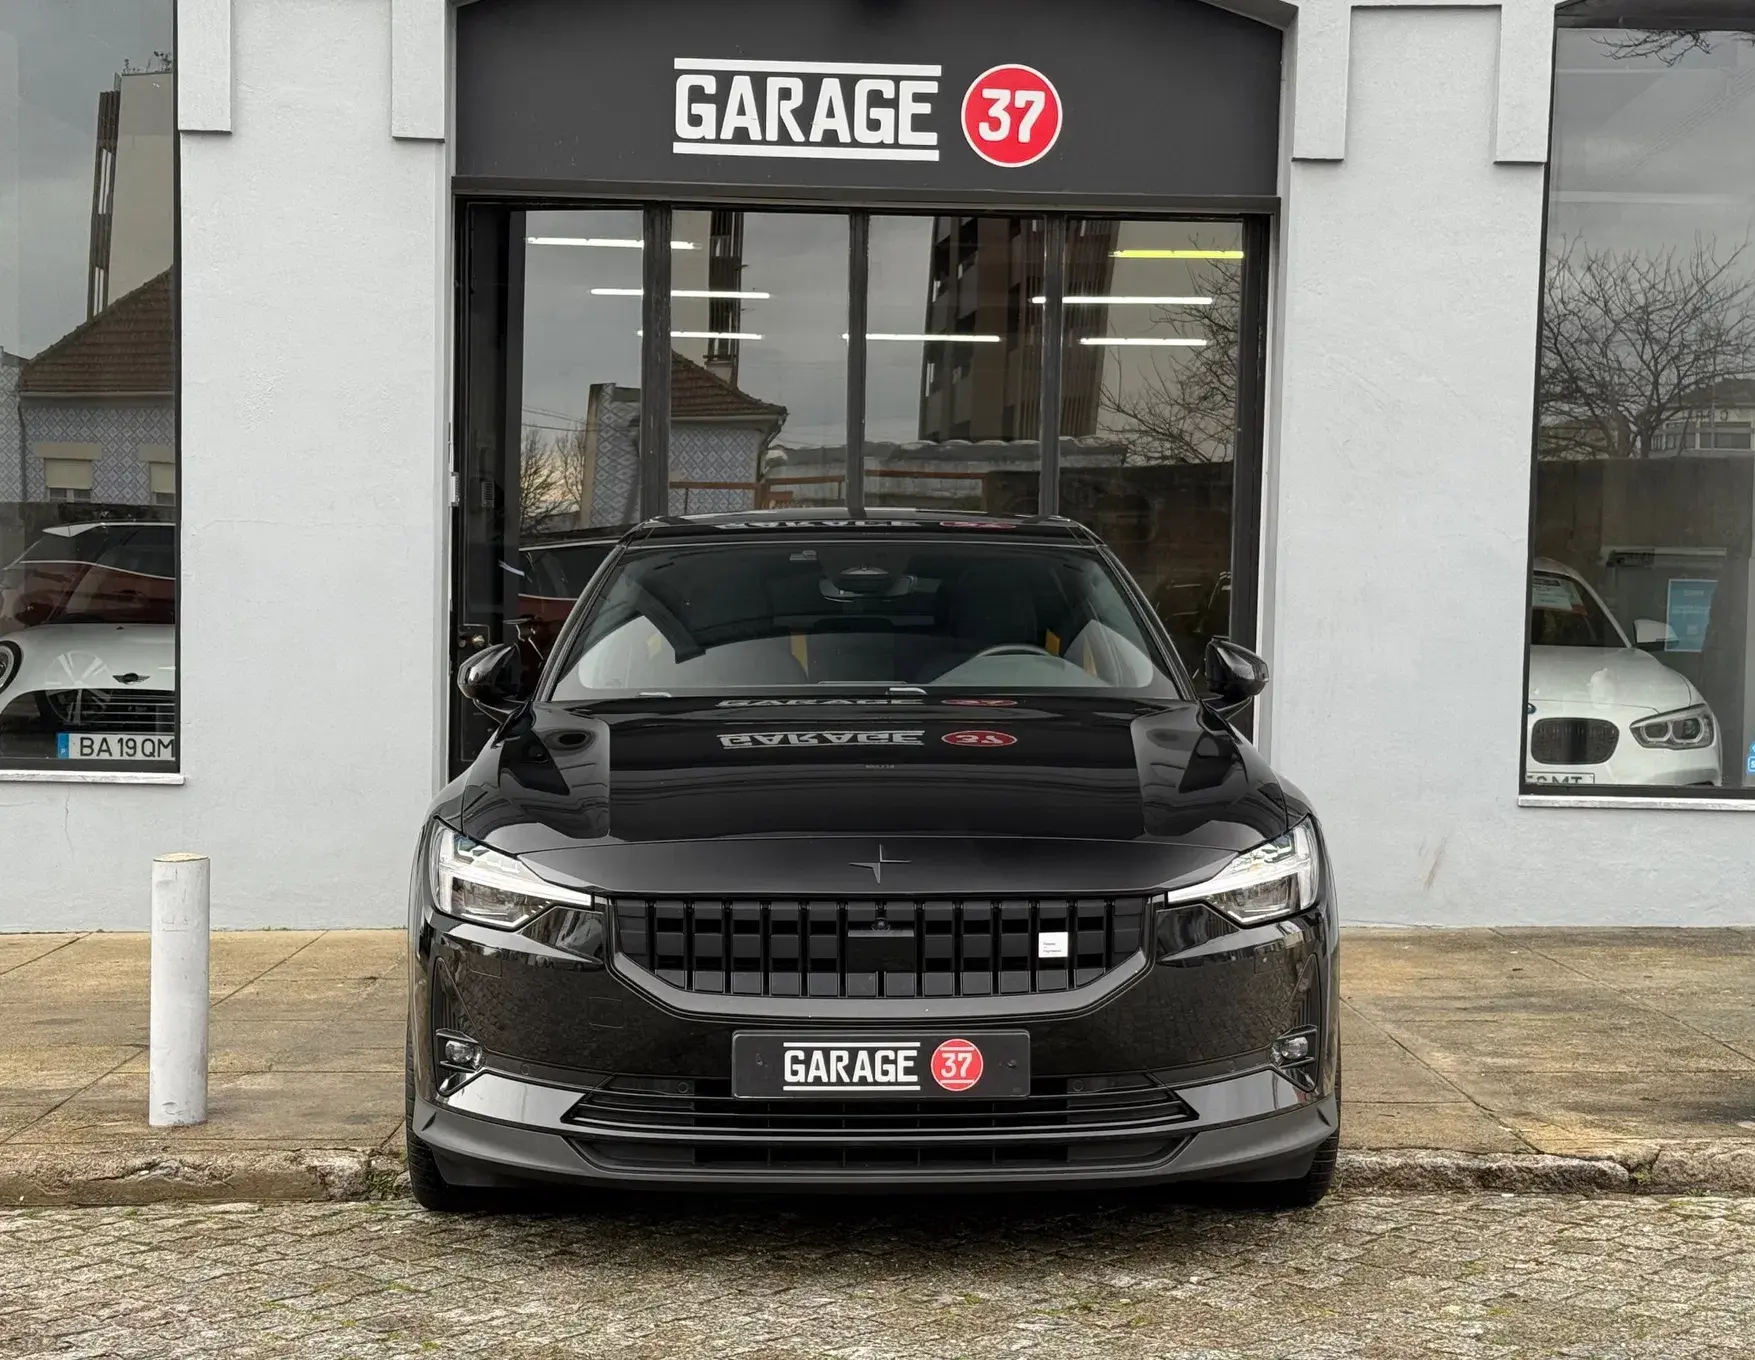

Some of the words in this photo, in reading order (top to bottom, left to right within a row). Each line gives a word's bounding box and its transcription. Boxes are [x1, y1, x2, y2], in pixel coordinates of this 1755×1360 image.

[675, 74, 938, 146] GARAGE
[978, 88, 1046, 143] 37
[80, 736, 113, 757] BA
[117, 737, 137, 757] 19
[141, 738, 175, 758] QM
[784, 1050, 918, 1083] GARAGE
[940, 1052, 973, 1078] 37
